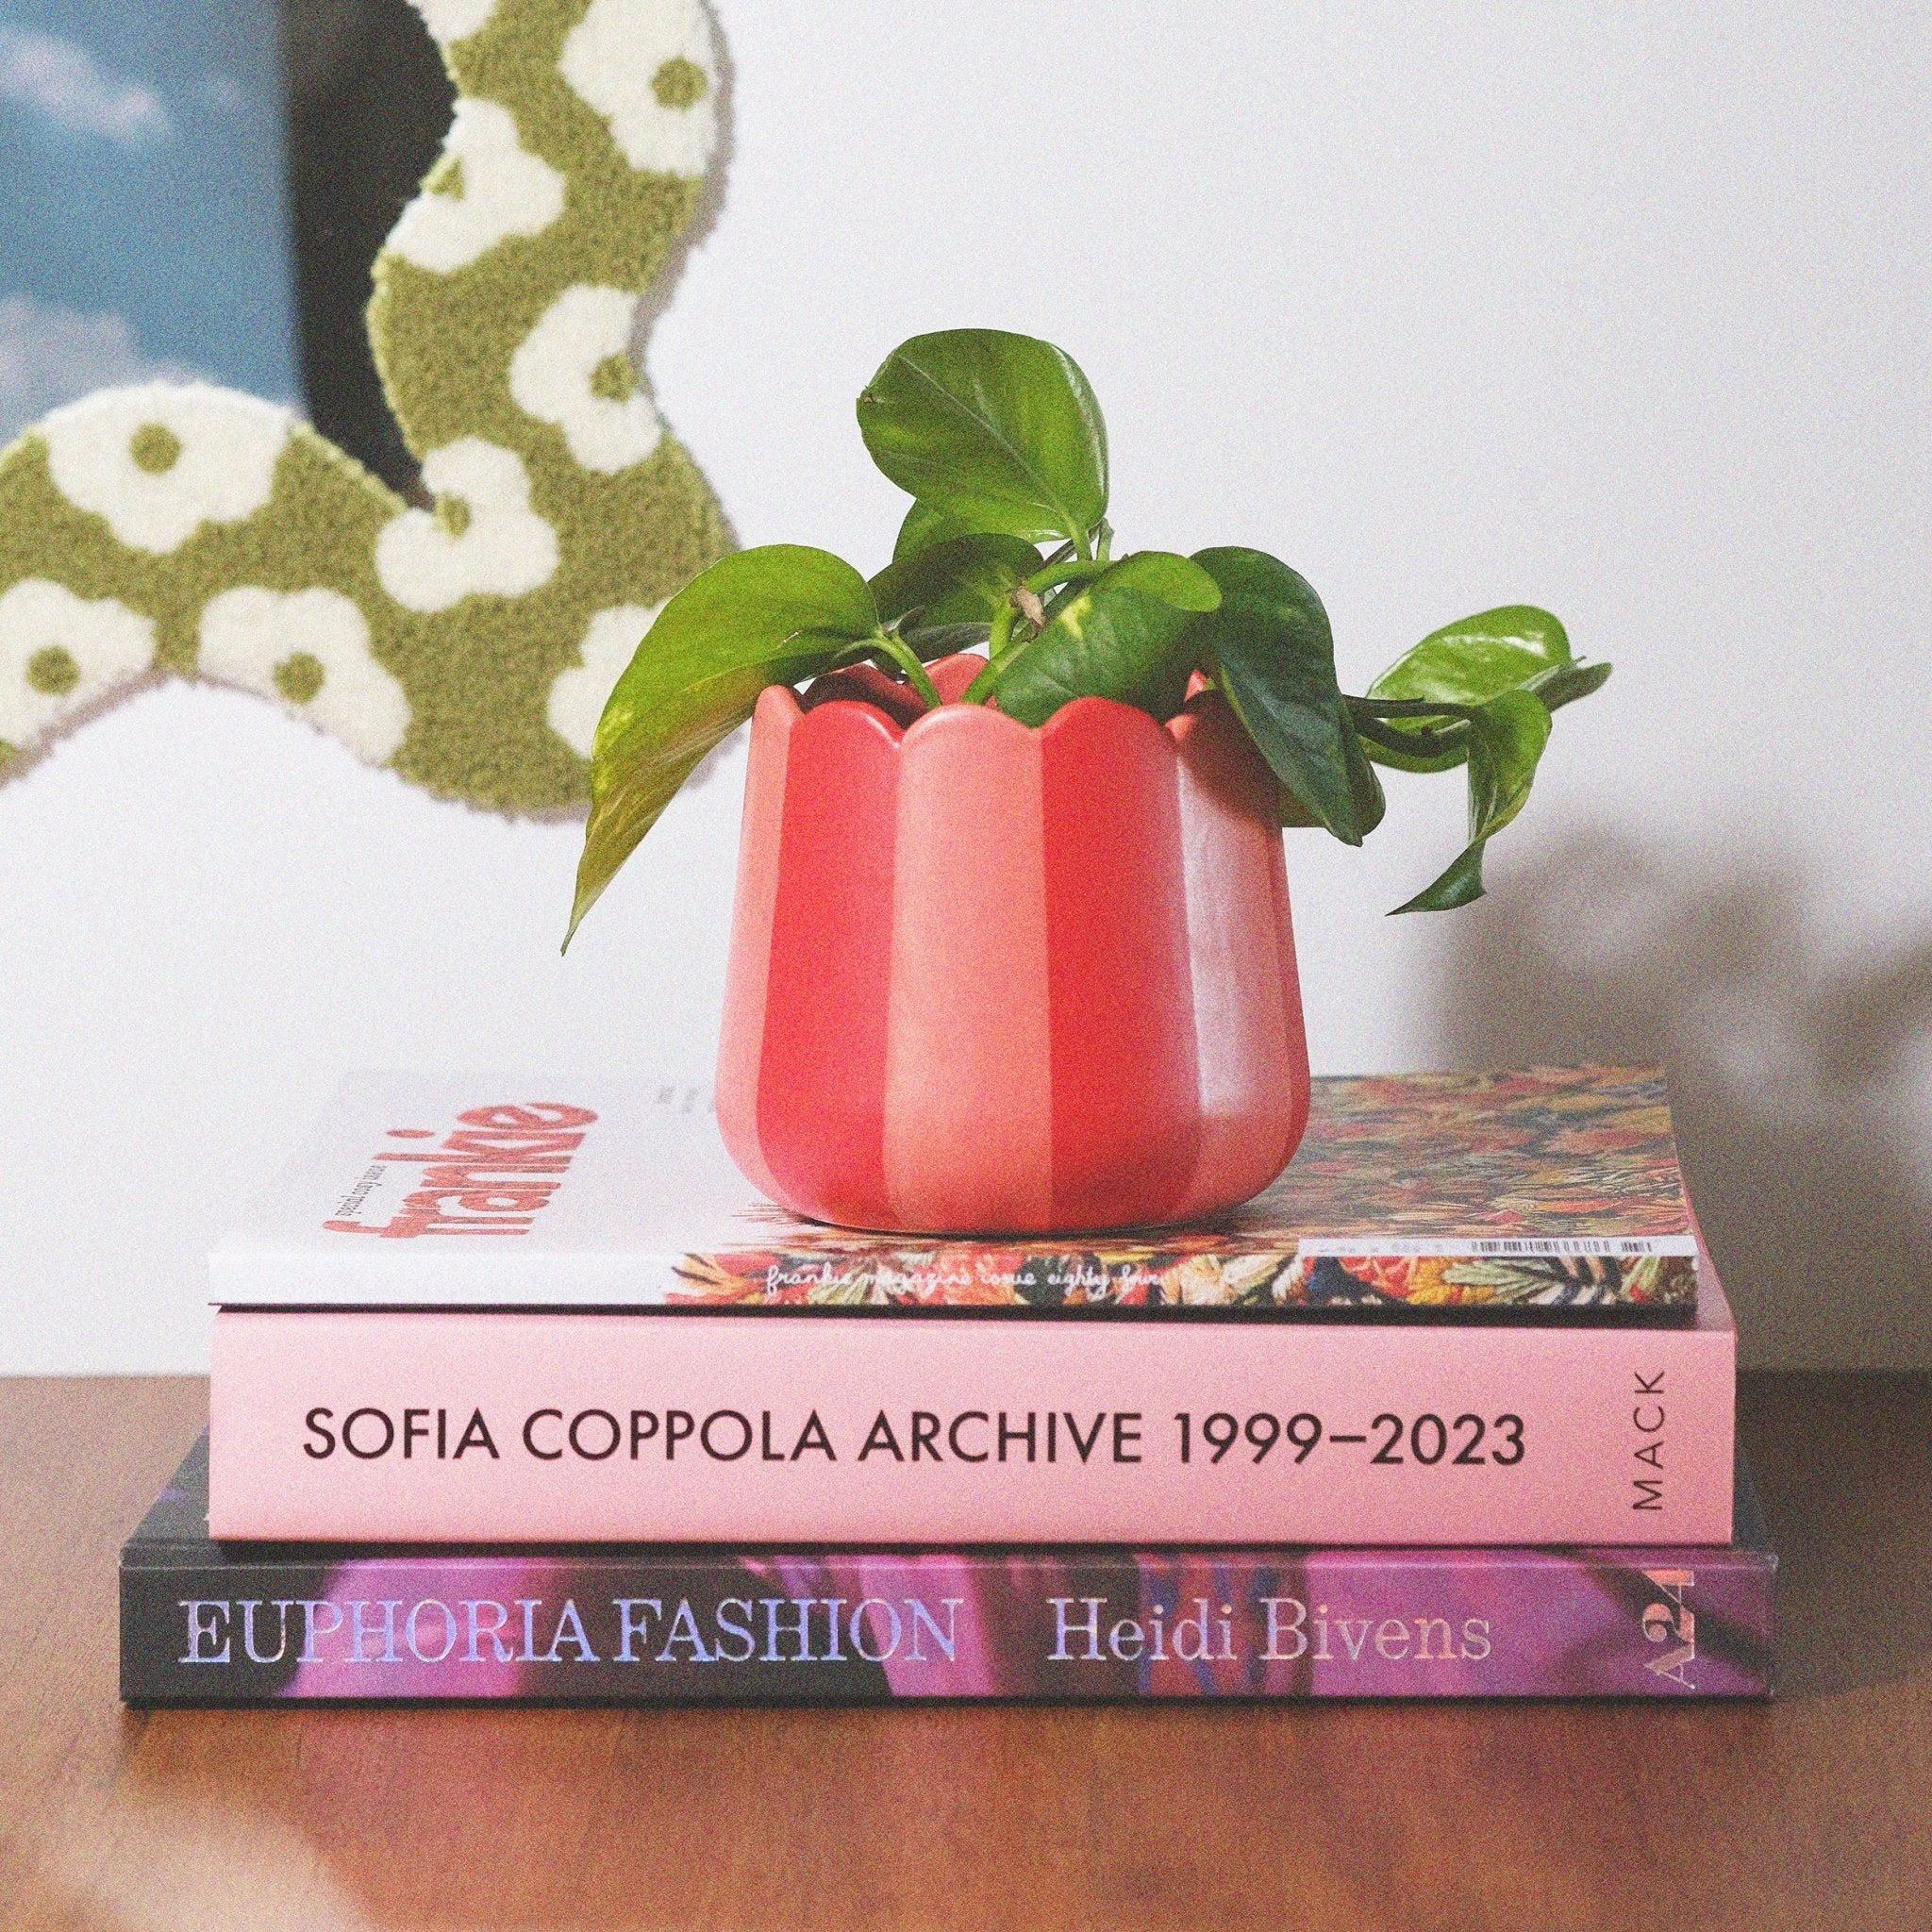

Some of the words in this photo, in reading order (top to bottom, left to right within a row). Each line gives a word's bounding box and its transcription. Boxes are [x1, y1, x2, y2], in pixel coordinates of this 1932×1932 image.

[322, 1102, 598, 1239] frankie
[334, 1195, 365, 1217] special
[766, 1262, 853, 1297] frankie
[865, 1268, 973, 1299] magazine
[975, 1261, 1037, 1286] issue
[1046, 1263, 1111, 1302] eighty
[304, 1408, 500, 1460] SOFIA
[523, 1408, 838, 1462] COPPOLA
[858, 1411, 1142, 1463] ARCHIVE
[1633, 1371, 1665, 1510] MACK
[178, 1599, 600, 1664] EUPHORIA
[612, 1598, 963, 1663] FASHION
[1045, 1597, 1238, 1662] Heidi
[1259, 1597, 1492, 1662] Bivens
[1642, 1569, 1695, 1689] A24
